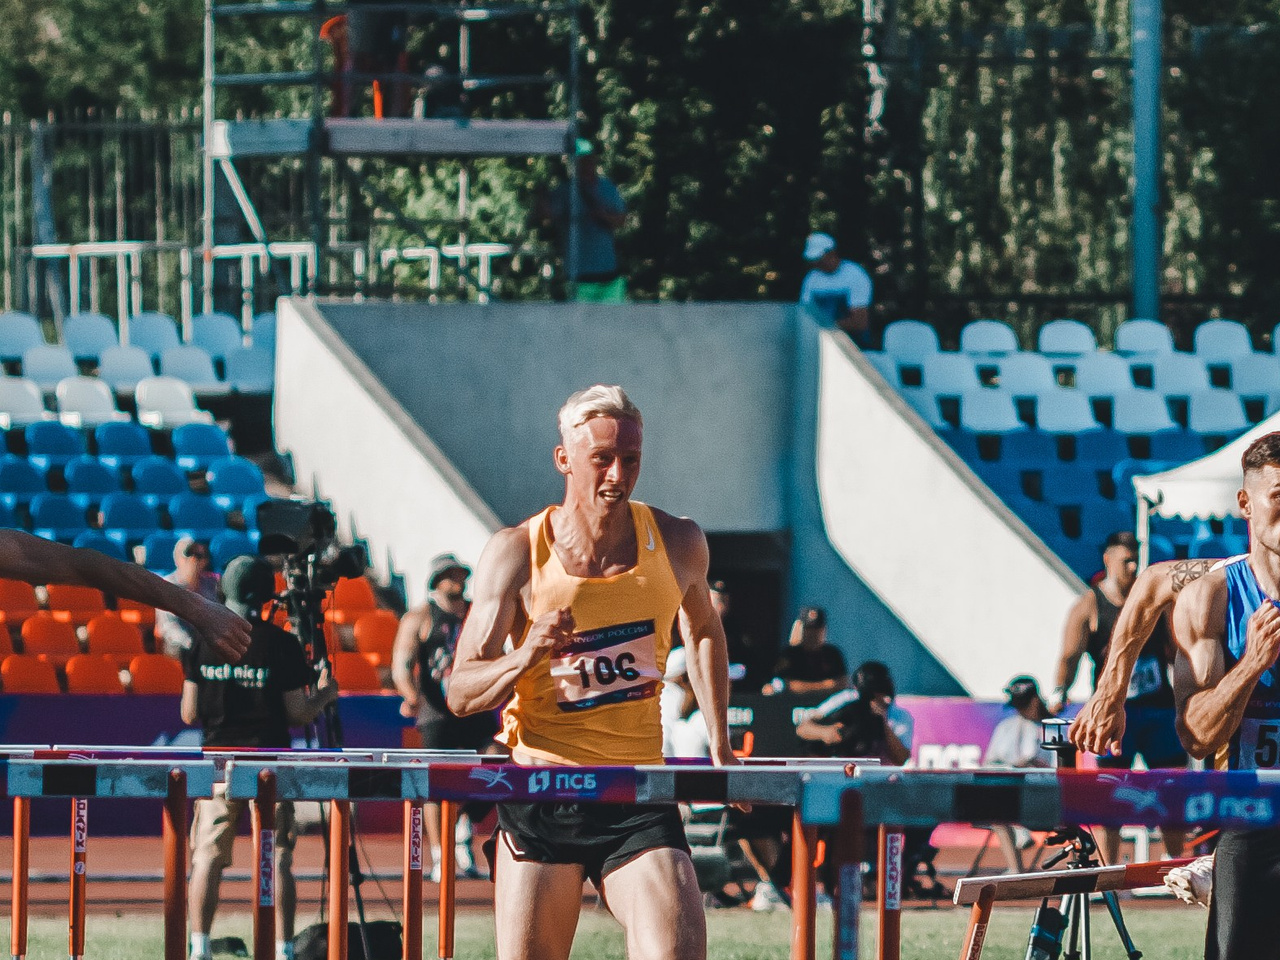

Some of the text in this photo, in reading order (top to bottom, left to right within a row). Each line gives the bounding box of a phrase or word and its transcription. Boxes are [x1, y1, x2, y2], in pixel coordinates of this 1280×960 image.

[573, 651, 640, 689] 106
[555, 773, 597, 790] ПСБ
[76, 800, 86, 848] OLANIK
[412, 809, 421, 862] POLANIK
